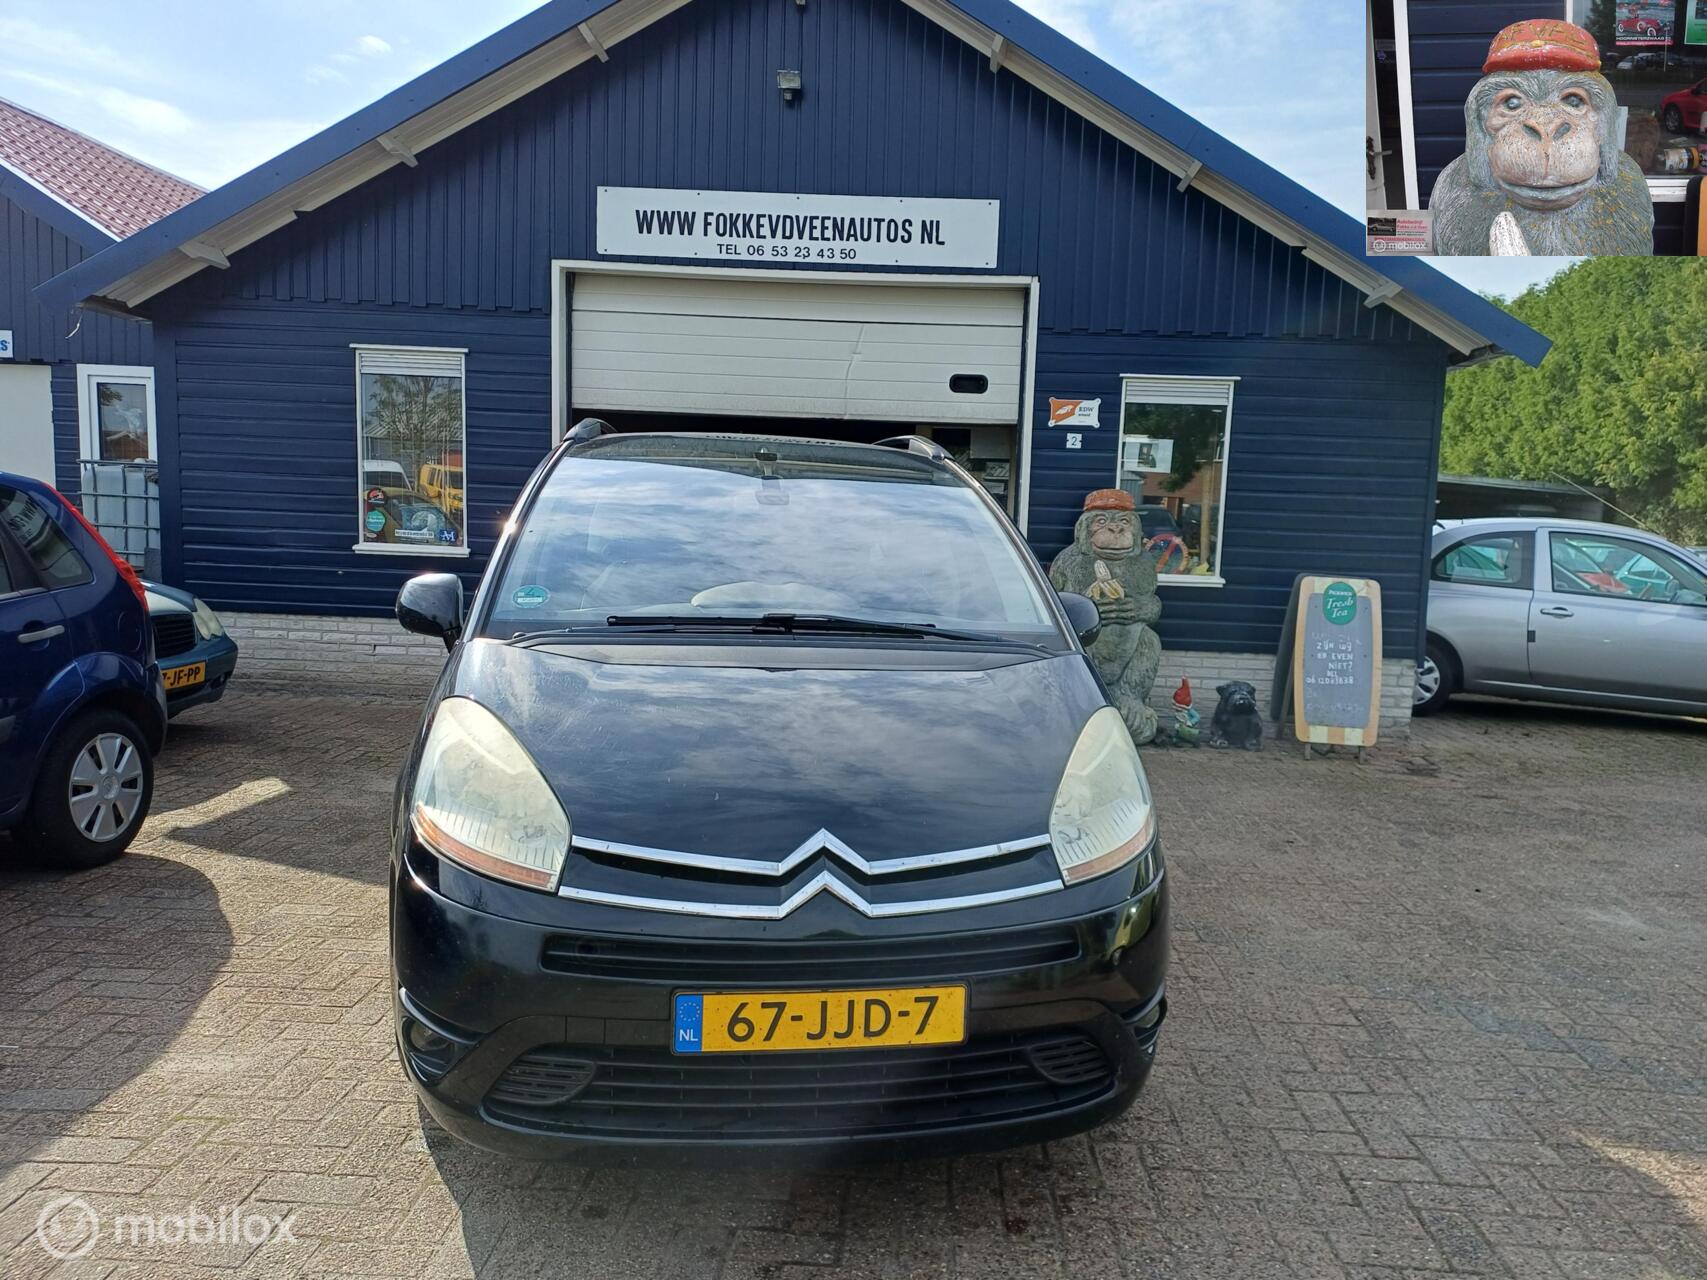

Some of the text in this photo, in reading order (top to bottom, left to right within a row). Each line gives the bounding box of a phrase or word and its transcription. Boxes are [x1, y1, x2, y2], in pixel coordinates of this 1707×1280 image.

[635, 209, 945, 246] WWW FOKKEVDVEENAUTOS NL
[716, 243, 857, 260] TEL 06 53 23 43 50
[1071, 436, 1078, 446] 2
[1331, 608, 1349, 618] Tea
[726, 995, 940, 1043] 67-JJD-7
[679, 1029, 699, 1042] NL
